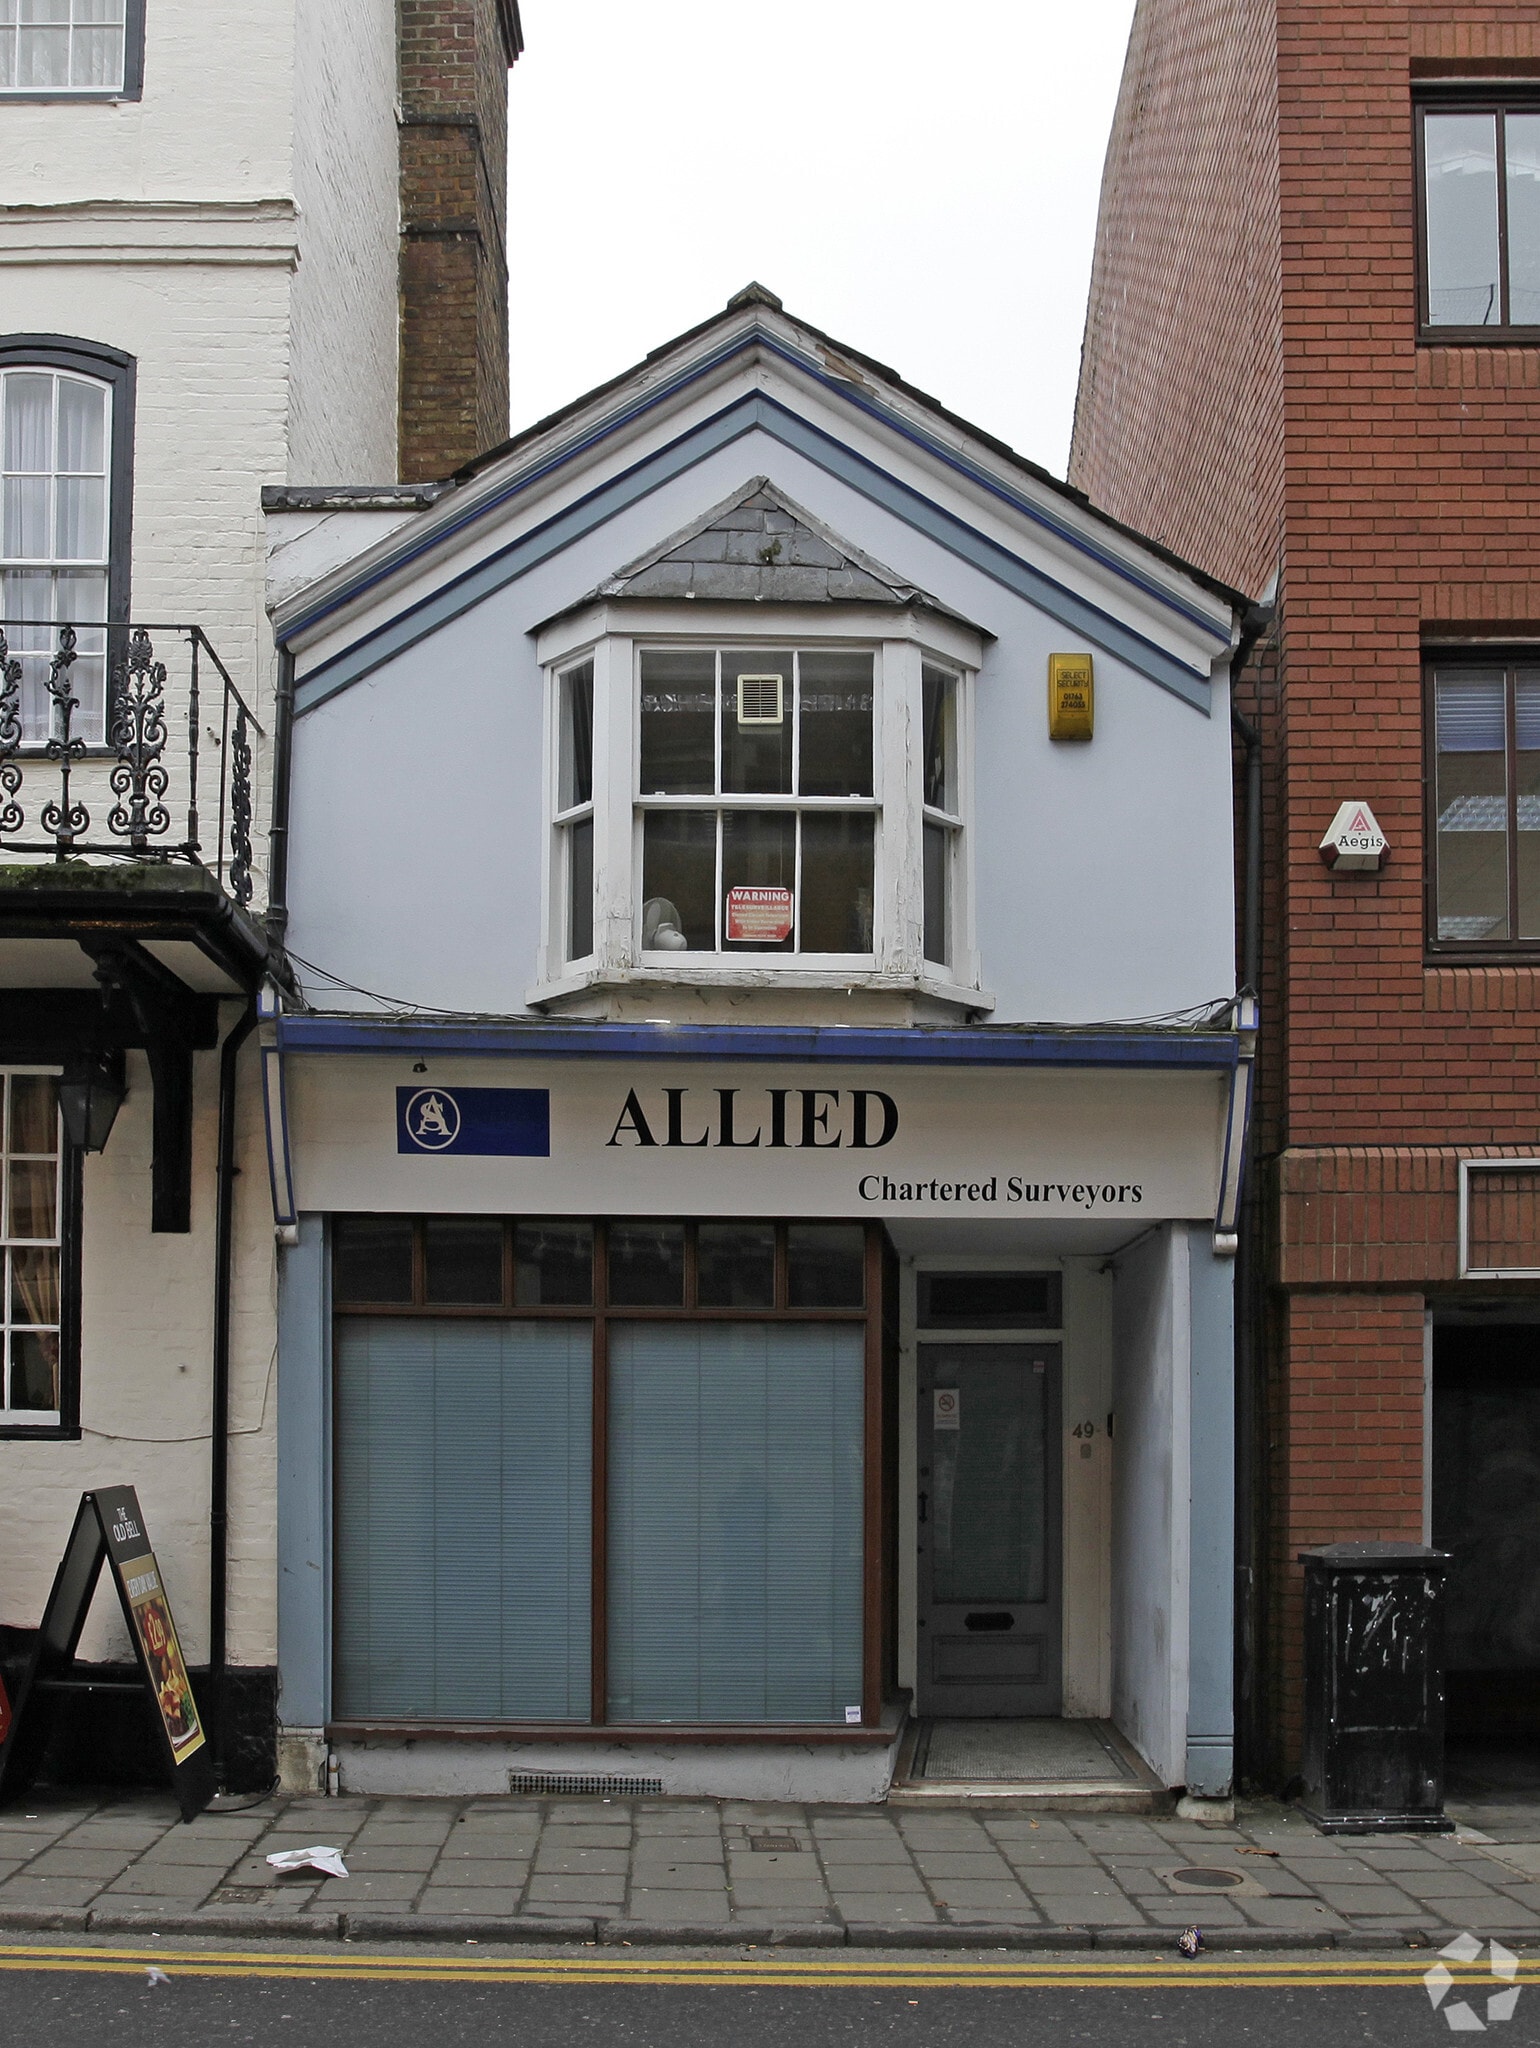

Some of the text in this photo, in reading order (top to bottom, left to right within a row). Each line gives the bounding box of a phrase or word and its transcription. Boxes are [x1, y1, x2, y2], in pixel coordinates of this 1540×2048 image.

[1338, 835, 1383, 850] Aegis
[731, 891, 789, 901] WARNING
[605, 1087, 899, 1148] ALLIED
[858, 1175, 1143, 1209] Chartered Surveyors
[1072, 1421, 1094, 1438] 49
[117, 1507, 127, 1521] THE
[113, 1520, 140, 1541] OLD BELL
